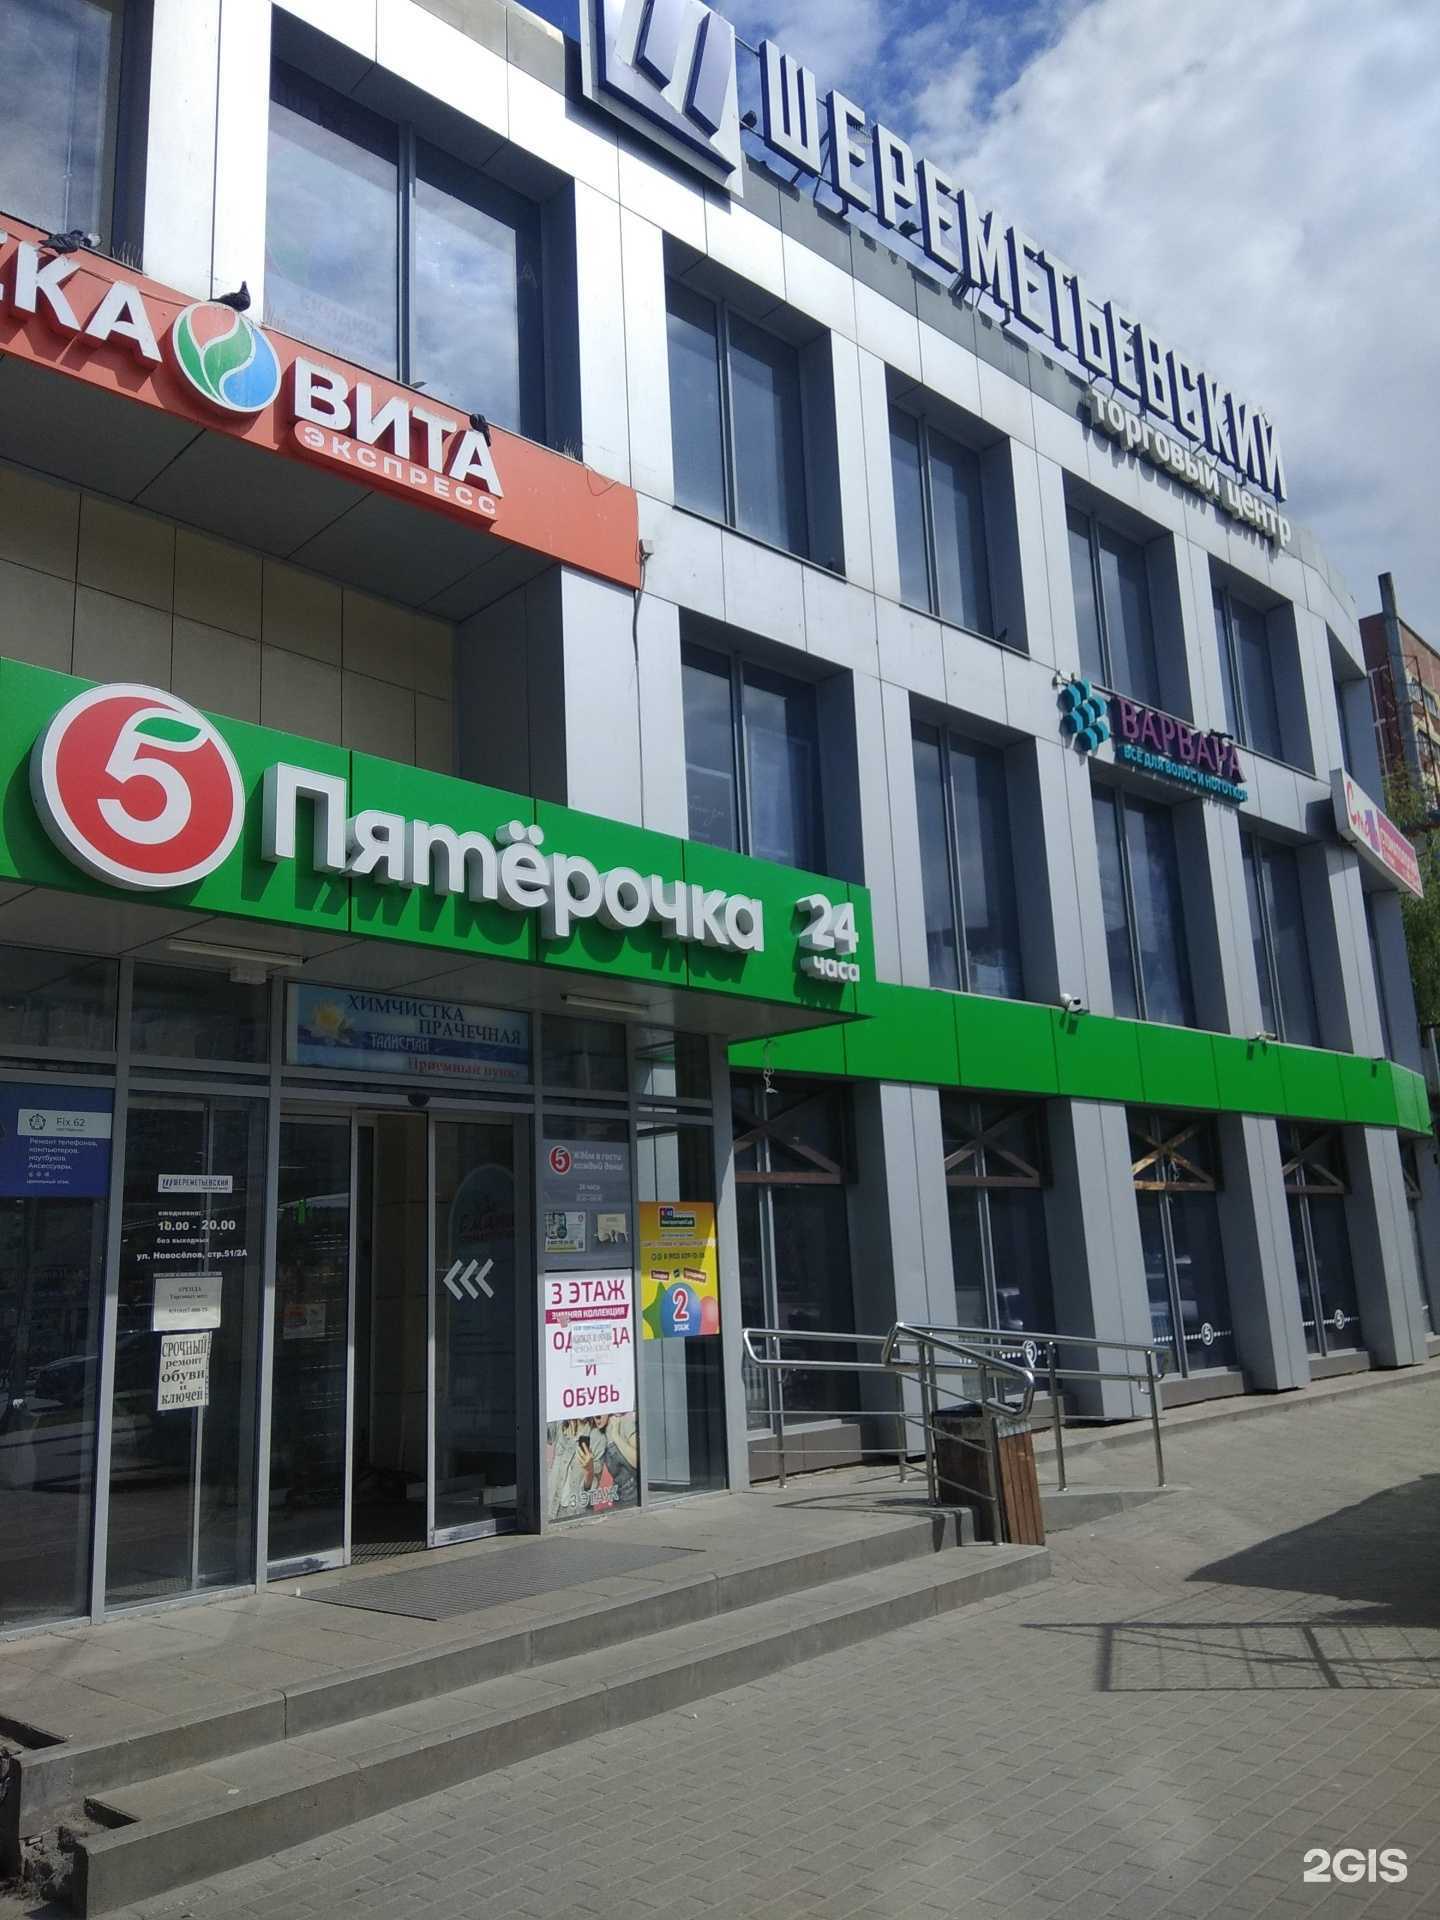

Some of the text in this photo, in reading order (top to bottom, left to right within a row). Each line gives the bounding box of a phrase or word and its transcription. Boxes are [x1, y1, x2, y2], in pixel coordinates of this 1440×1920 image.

[759, 39, 1288, 503] ШЕРЕМЕТЬЕВСКИЙ
[0, 231, 163, 363] КА
[294, 356, 504, 498] ВИТА
[303, 426, 496, 514] ЭКСПРЕСС
[1090, 387, 1292, 547] торговый центр
[1118, 698, 1247, 783] ВАРВАРА
[97, 707, 211, 846] 5
[262, 762, 764, 952] Пятёрочка
[797, 893, 859, 954] 24
[803, 955, 860, 982] часа
[346, 993, 465, 1021] ХИМЧИСТКА
[418, 1019, 521, 1045] ПРАЧЕЧНАЯ
[158, 1221, 189, 1231] 10.00
[201, 1219, 236, 1231] 20.00
[551, 1280, 626, 1305] 3 ЭТАЖ
[673, 1288, 689, 1321] 2
[161, 1335, 208, 1357] СРОЧНЫЙ
[161, 1369, 205, 1384] обуви
[165, 1357, 203, 1370] ремонт
[585, 1364, 597, 1376] И
[161, 1386, 203, 1406] ключей
[563, 1384, 620, 1408] ОБУВЬ
